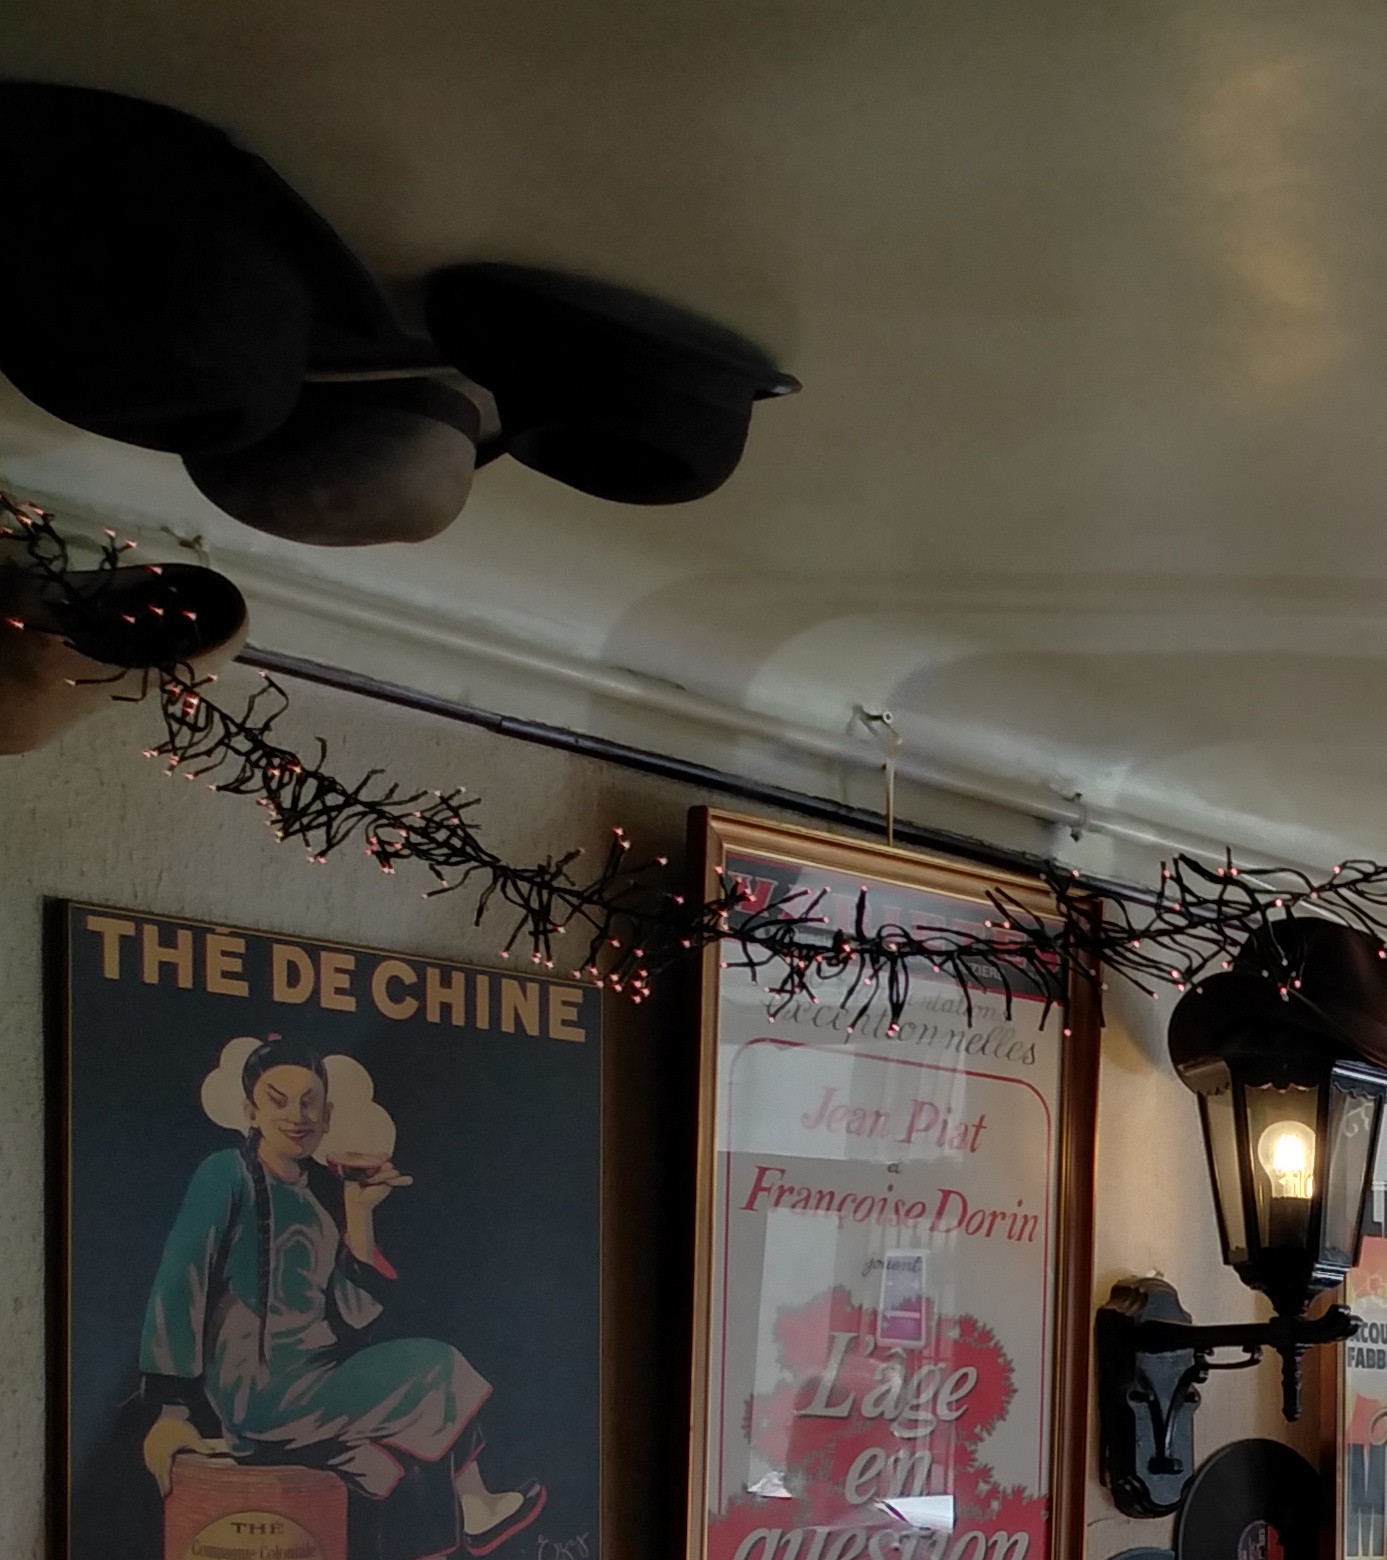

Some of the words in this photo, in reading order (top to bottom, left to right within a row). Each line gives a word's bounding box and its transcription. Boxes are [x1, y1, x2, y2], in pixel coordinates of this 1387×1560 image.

[272, 943, 357, 1012] DE
[371, 960, 587, 1043] CHINE
[766, 998, 1036, 1065] excetonnelles
[802, 1086, 889, 1138] Jean
[897, 1100, 987, 1153] Piat
[740, 1166, 927, 1230] Françoise
[930, 1188, 1039, 1242] Dorin
[845, 1447, 932, 1504] en
